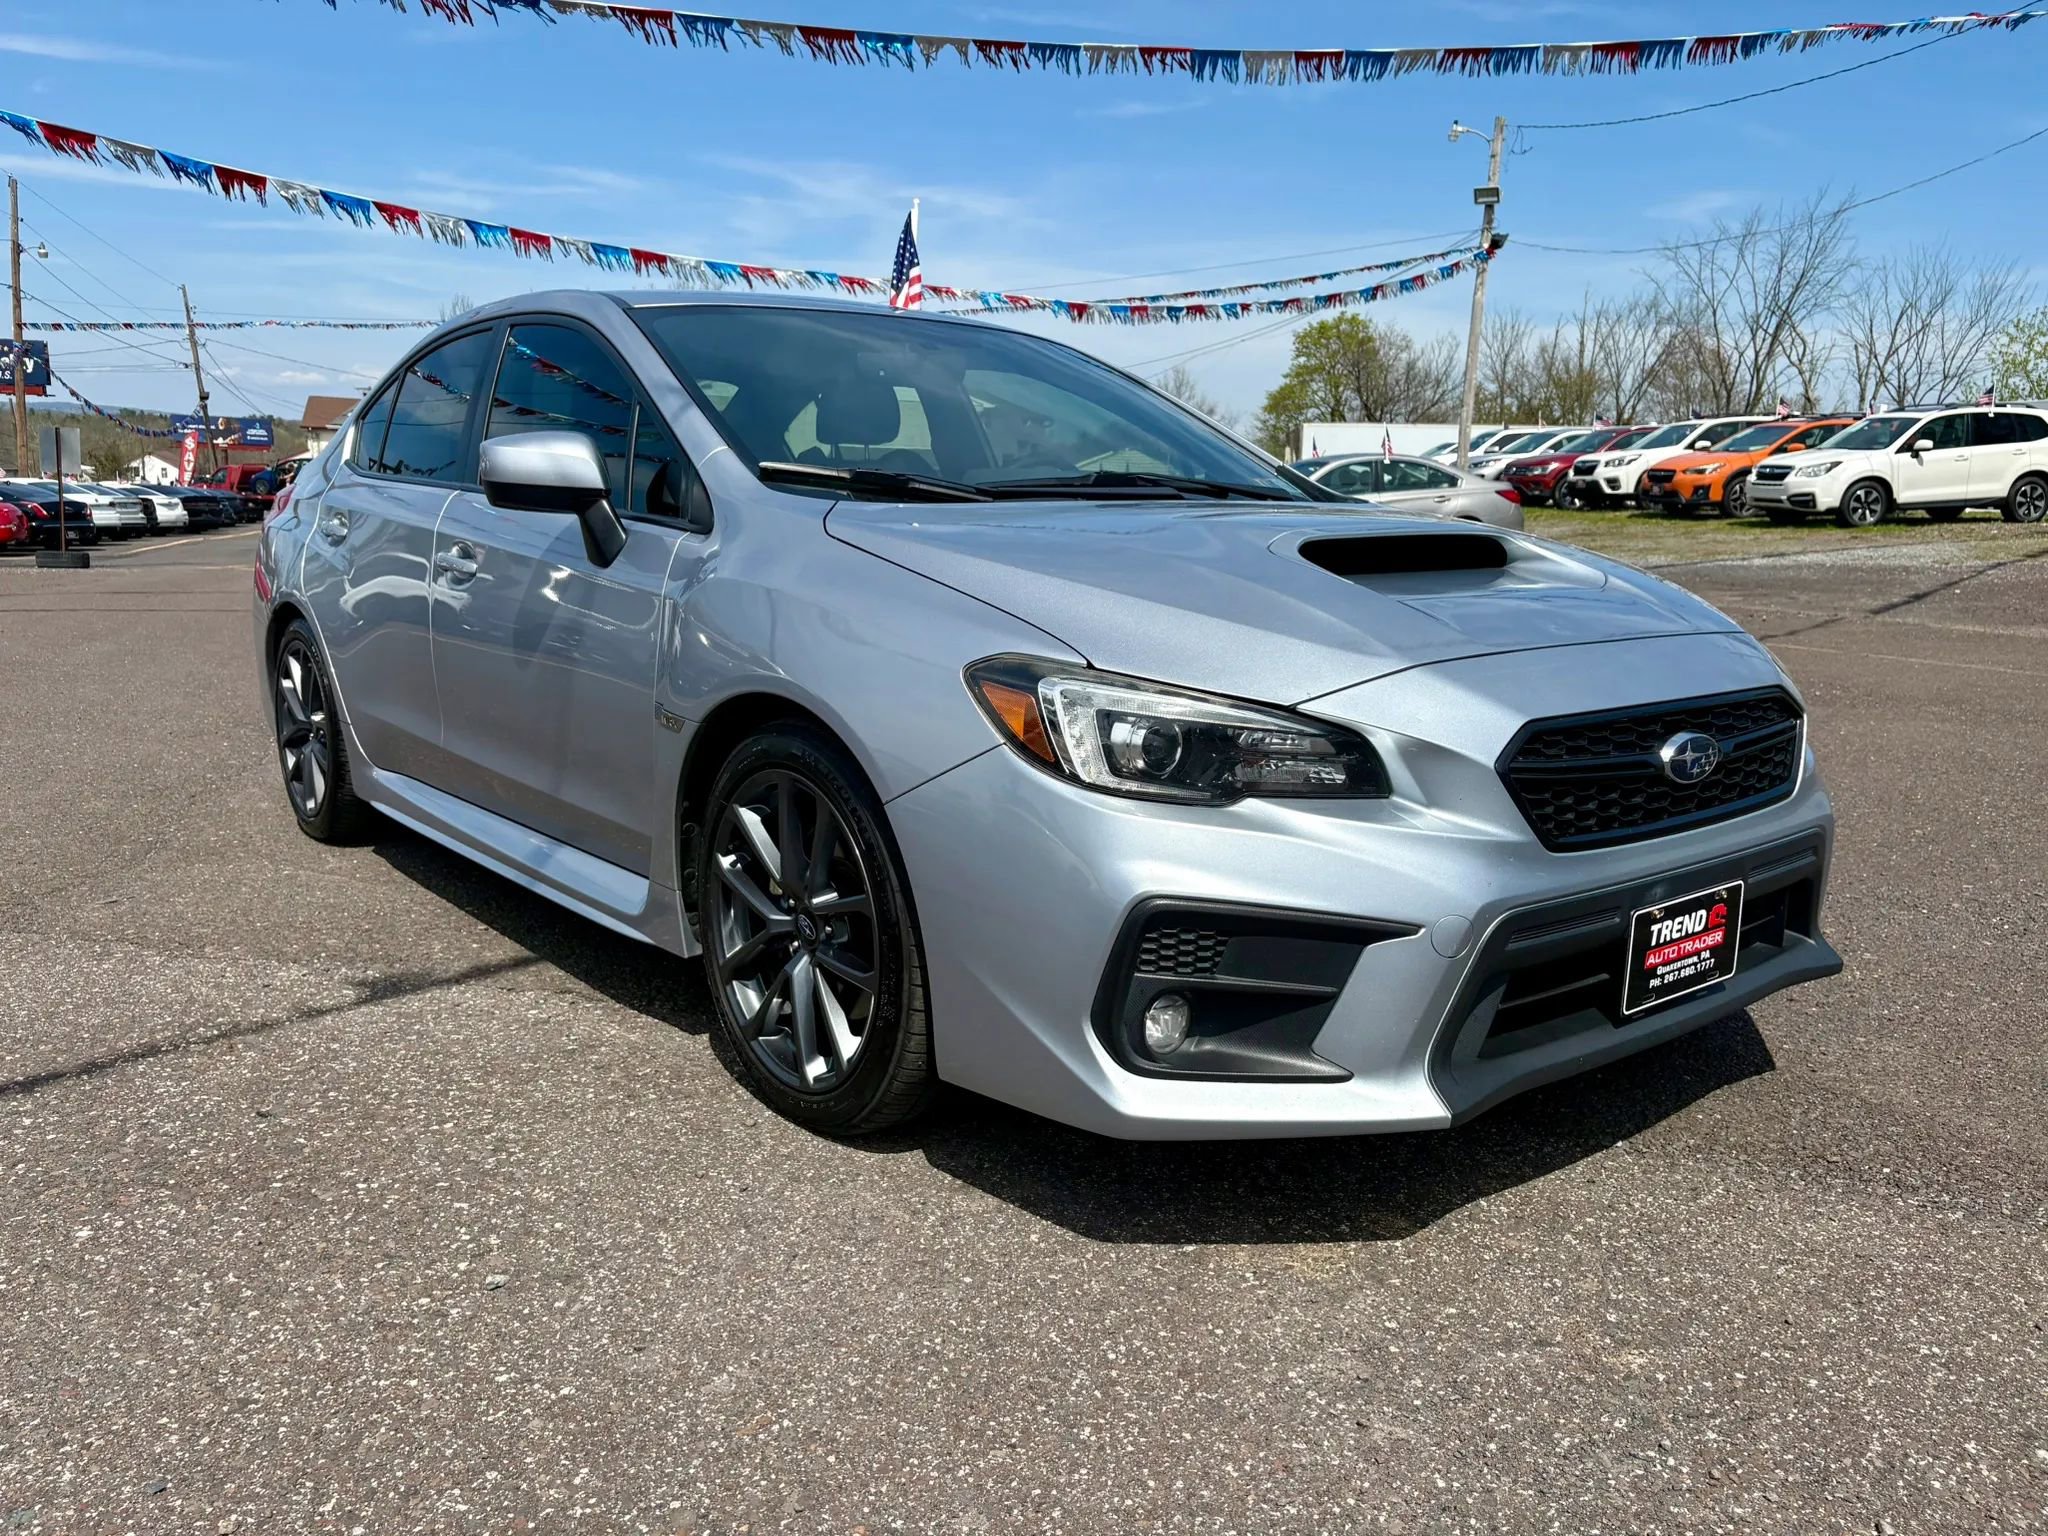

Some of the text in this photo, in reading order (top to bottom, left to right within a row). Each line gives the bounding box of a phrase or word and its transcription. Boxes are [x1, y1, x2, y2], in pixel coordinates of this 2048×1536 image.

[1650, 909, 1707, 947] TREND
[1647, 931, 1723, 966] AUTO TRADER
[1701, 950, 1710, 961] PA
[1649, 977, 1662, 989] PH:
